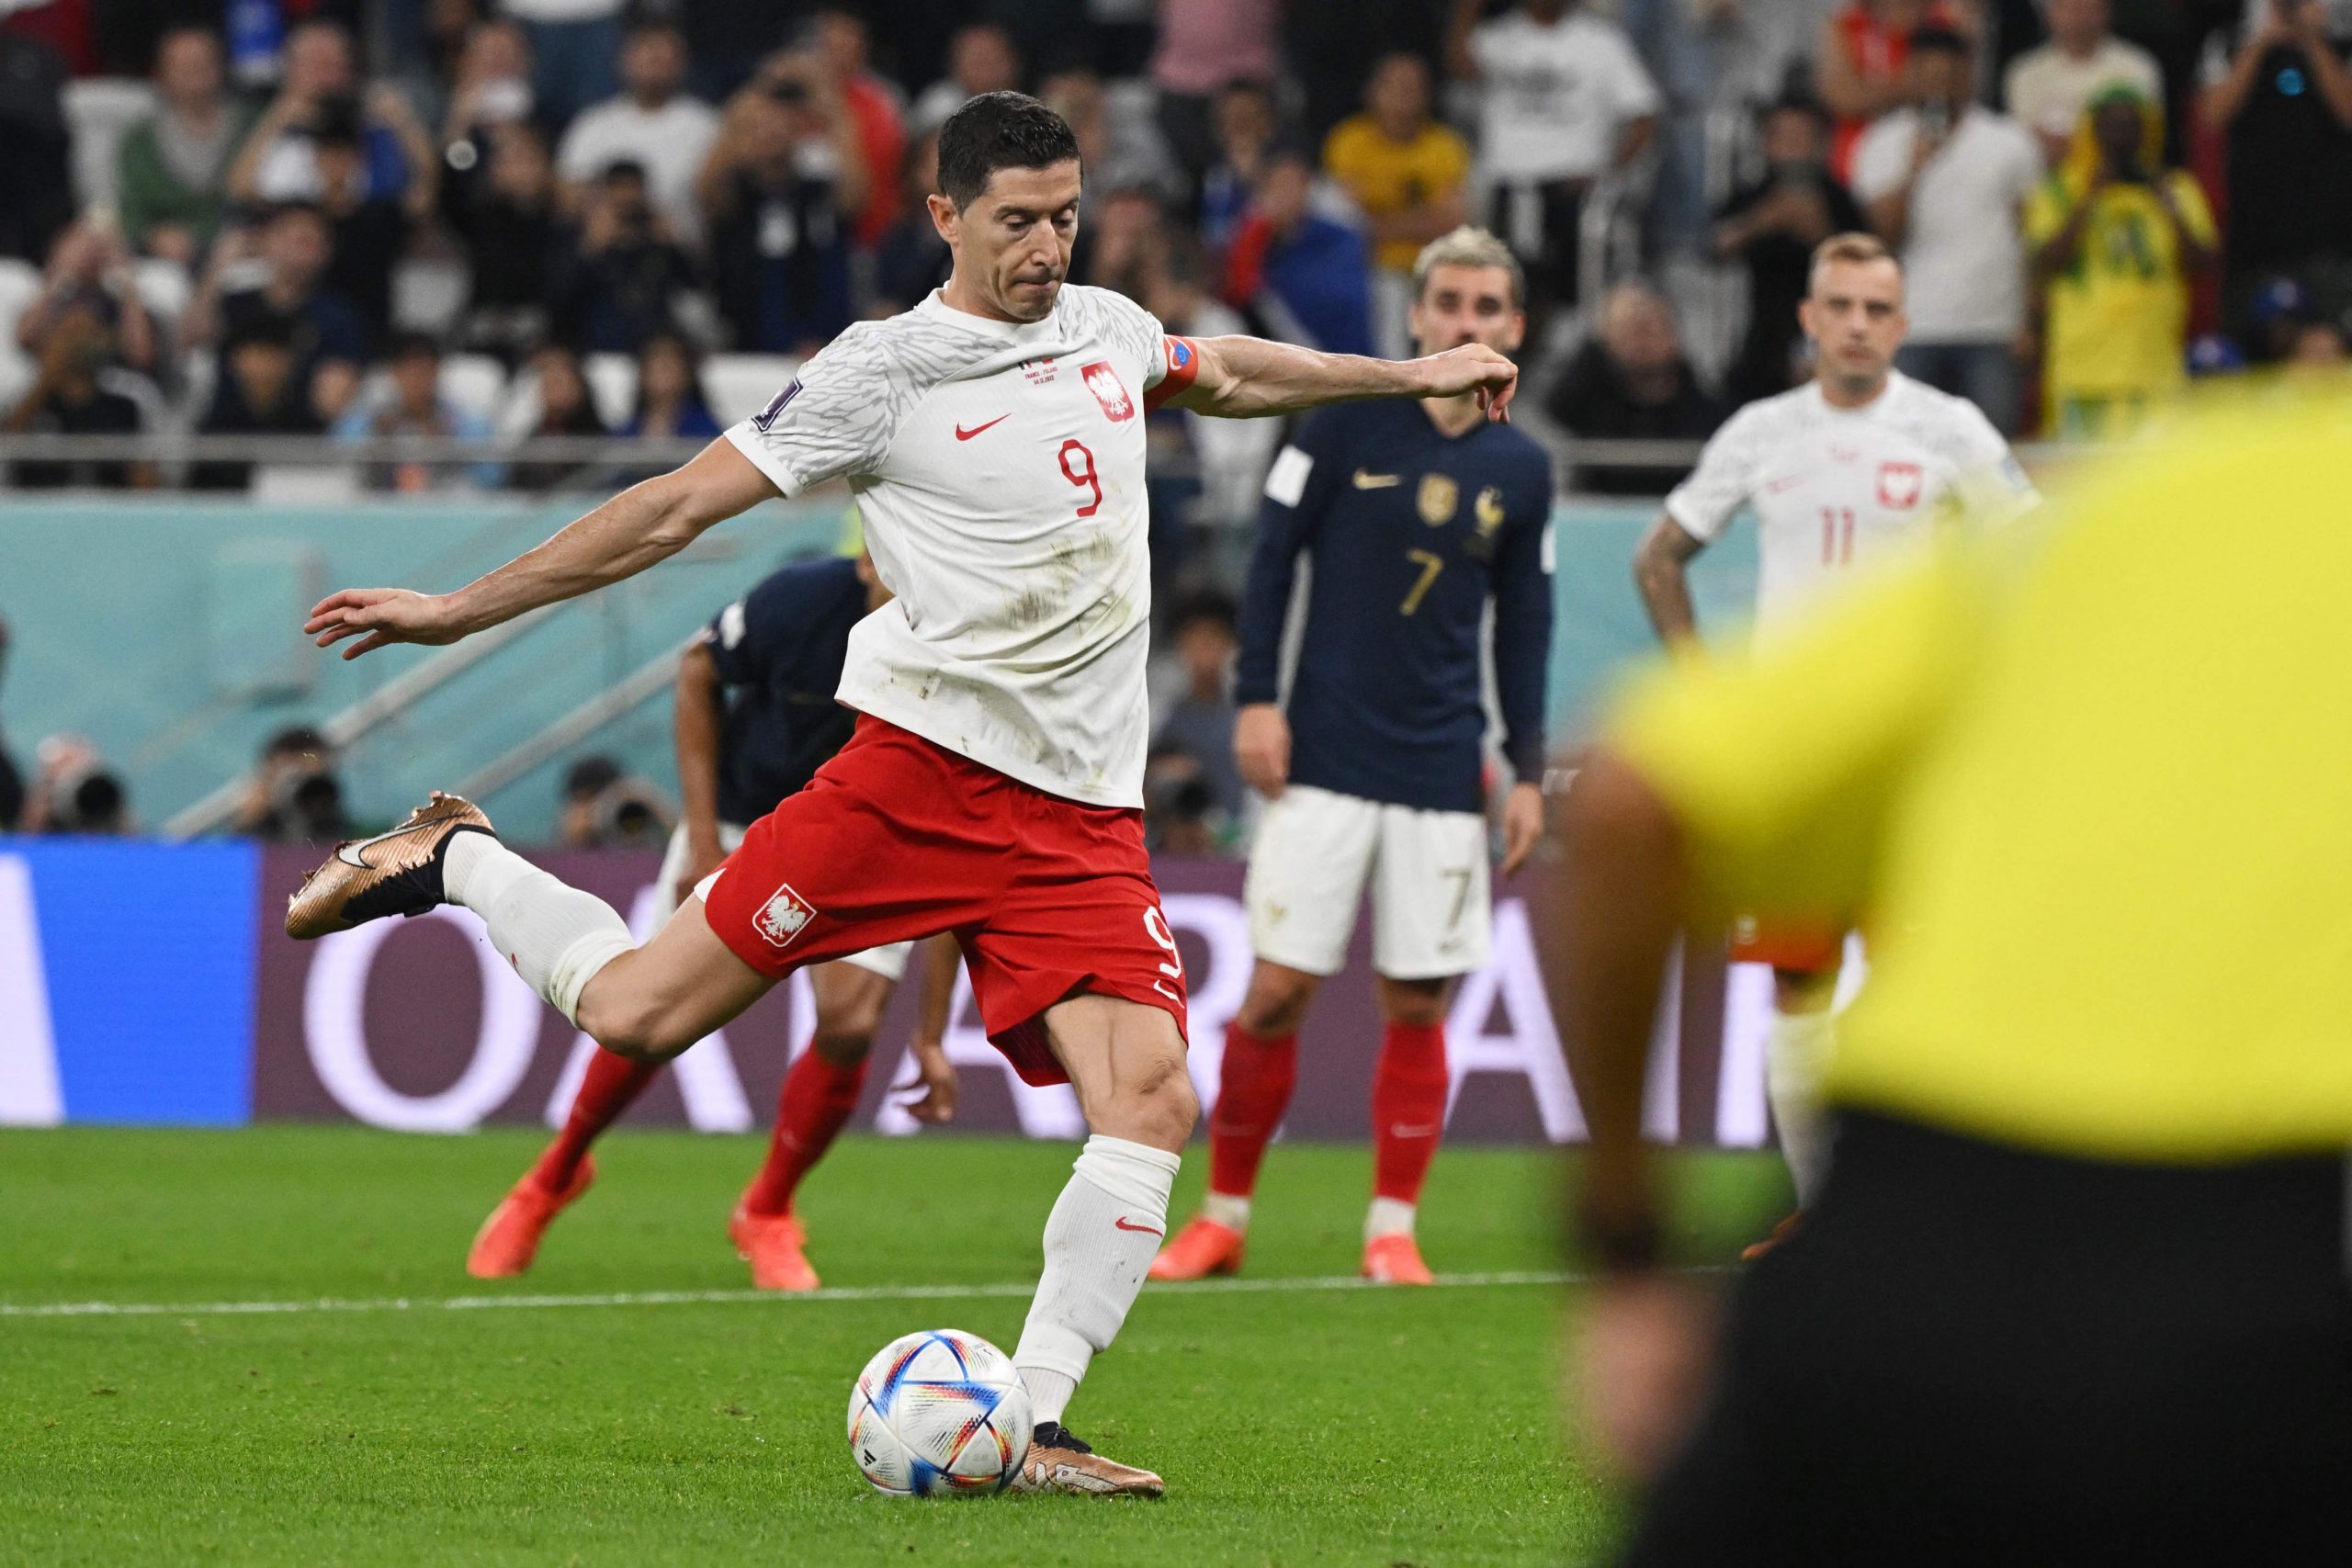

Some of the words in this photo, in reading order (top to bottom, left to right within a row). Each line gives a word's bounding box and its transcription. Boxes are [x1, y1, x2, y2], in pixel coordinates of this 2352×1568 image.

[1058, 439, 1102, 517] 9
[1819, 505, 1855, 566] 11
[1400, 548, 1443, 616] 7
[1438, 865, 1473, 931] 7
[1142, 905, 1182, 979] 9
[303, 885, 1284, 1142] QAAR
